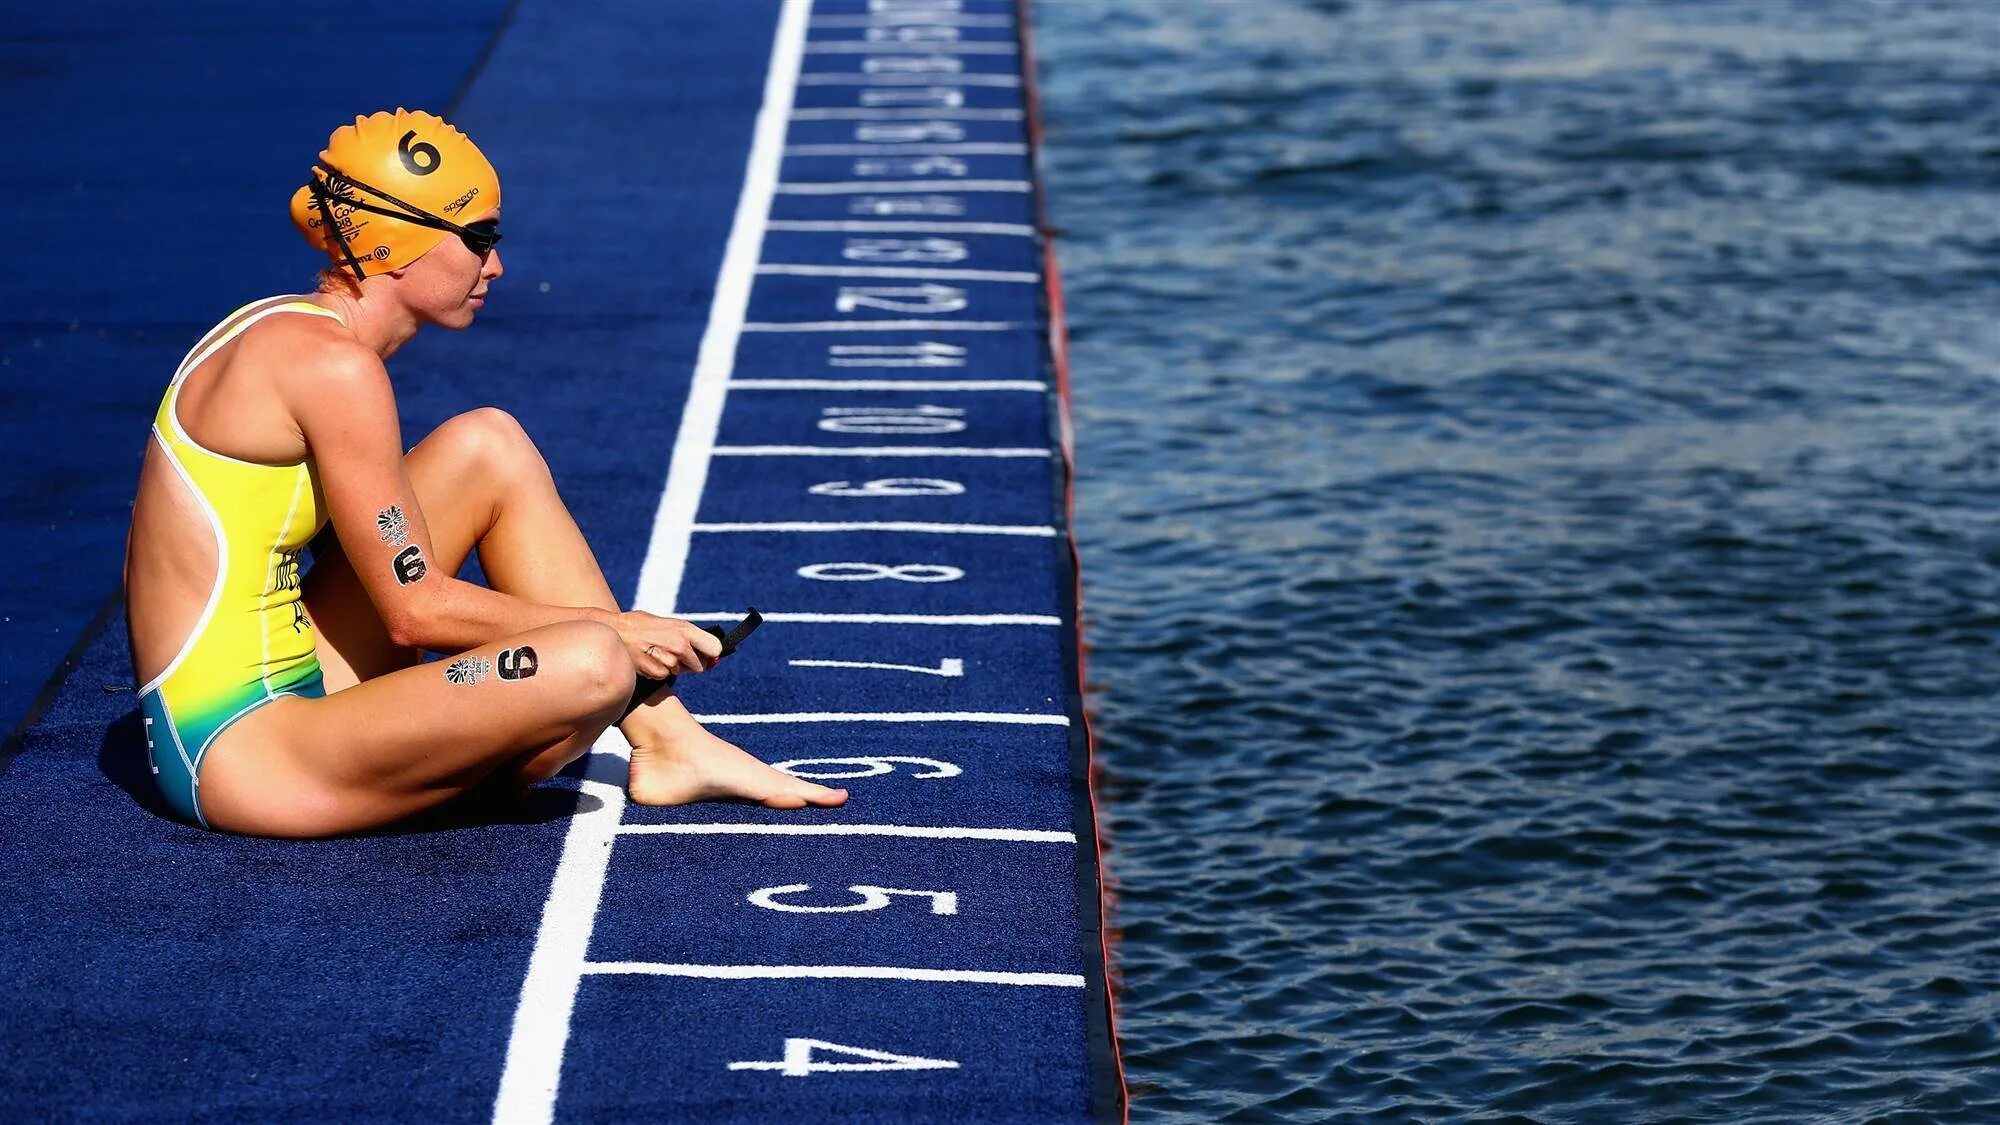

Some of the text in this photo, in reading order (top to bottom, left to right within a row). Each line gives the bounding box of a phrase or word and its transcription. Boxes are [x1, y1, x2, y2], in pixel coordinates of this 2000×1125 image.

[398, 129, 441, 175] 6
[443, 187, 479, 213] speedo
[841, 237, 968, 262] 13
[835, 283, 968, 313] 12
[828, 341, 967, 367] 11
[818, 405, 966, 434] 10
[809, 478, 966, 497] 9
[393, 545, 427, 585] 6
[797, 563, 965, 583] 8
[497, 645, 538, 680] 6
[788, 658, 964, 677] 7
[771, 755, 964, 779] 6
[746, 882, 959, 915] 5
[727, 1037, 961, 1077] 4
